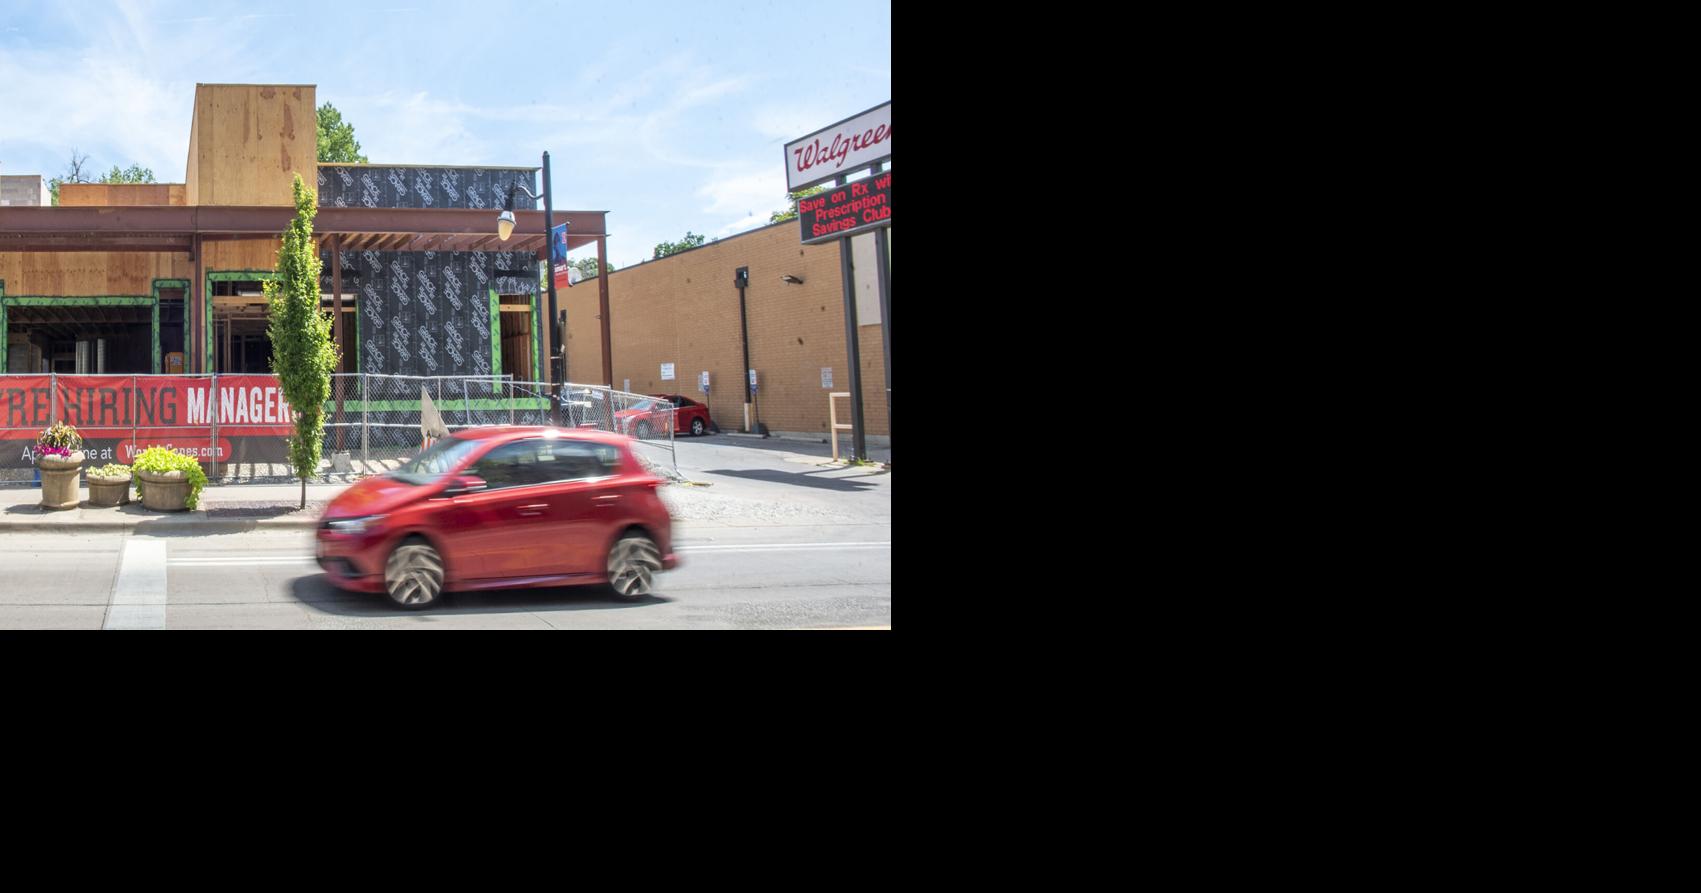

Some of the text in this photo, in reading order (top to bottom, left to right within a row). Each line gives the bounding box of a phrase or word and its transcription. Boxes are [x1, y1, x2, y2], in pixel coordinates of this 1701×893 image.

[363, 173, 381, 195] GRACE
[415, 183, 433, 205] GRACE
[441, 179, 458, 201] GRACE
[800, 197, 825, 213] Save
[832, 191, 846, 203] on
[852, 183, 869, 195] Rx
[816, 193, 886, 221] Prescription
[813, 206, 891, 236] Savings Club
[391, 260, 409, 282] GRACE
[419, 270, 436, 292] GRACE
[444, 266, 462, 288] GRACE
[469, 263, 487, 284] GRACE
[364, 283, 383, 305] GRACE
[391, 284, 409, 305] GRACE
[418, 293, 436, 314] GRACE
[443, 289, 461, 310] GRACE
[365, 307, 383, 328] GRACE
[392, 316, 410, 338] GRACE
[419, 325, 437, 348] GRACE
[445, 321, 464, 344] GRACE
[366, 340, 384, 361] GRACE
[392, 340, 410, 361] GRACE
[418, 348, 437, 370] GRACE
[444, 344, 463, 366] GRACE
[61, 387, 176, 425] HIRING
[187, 386, 302, 424] MANAGER
[100, 447, 112, 459] at
